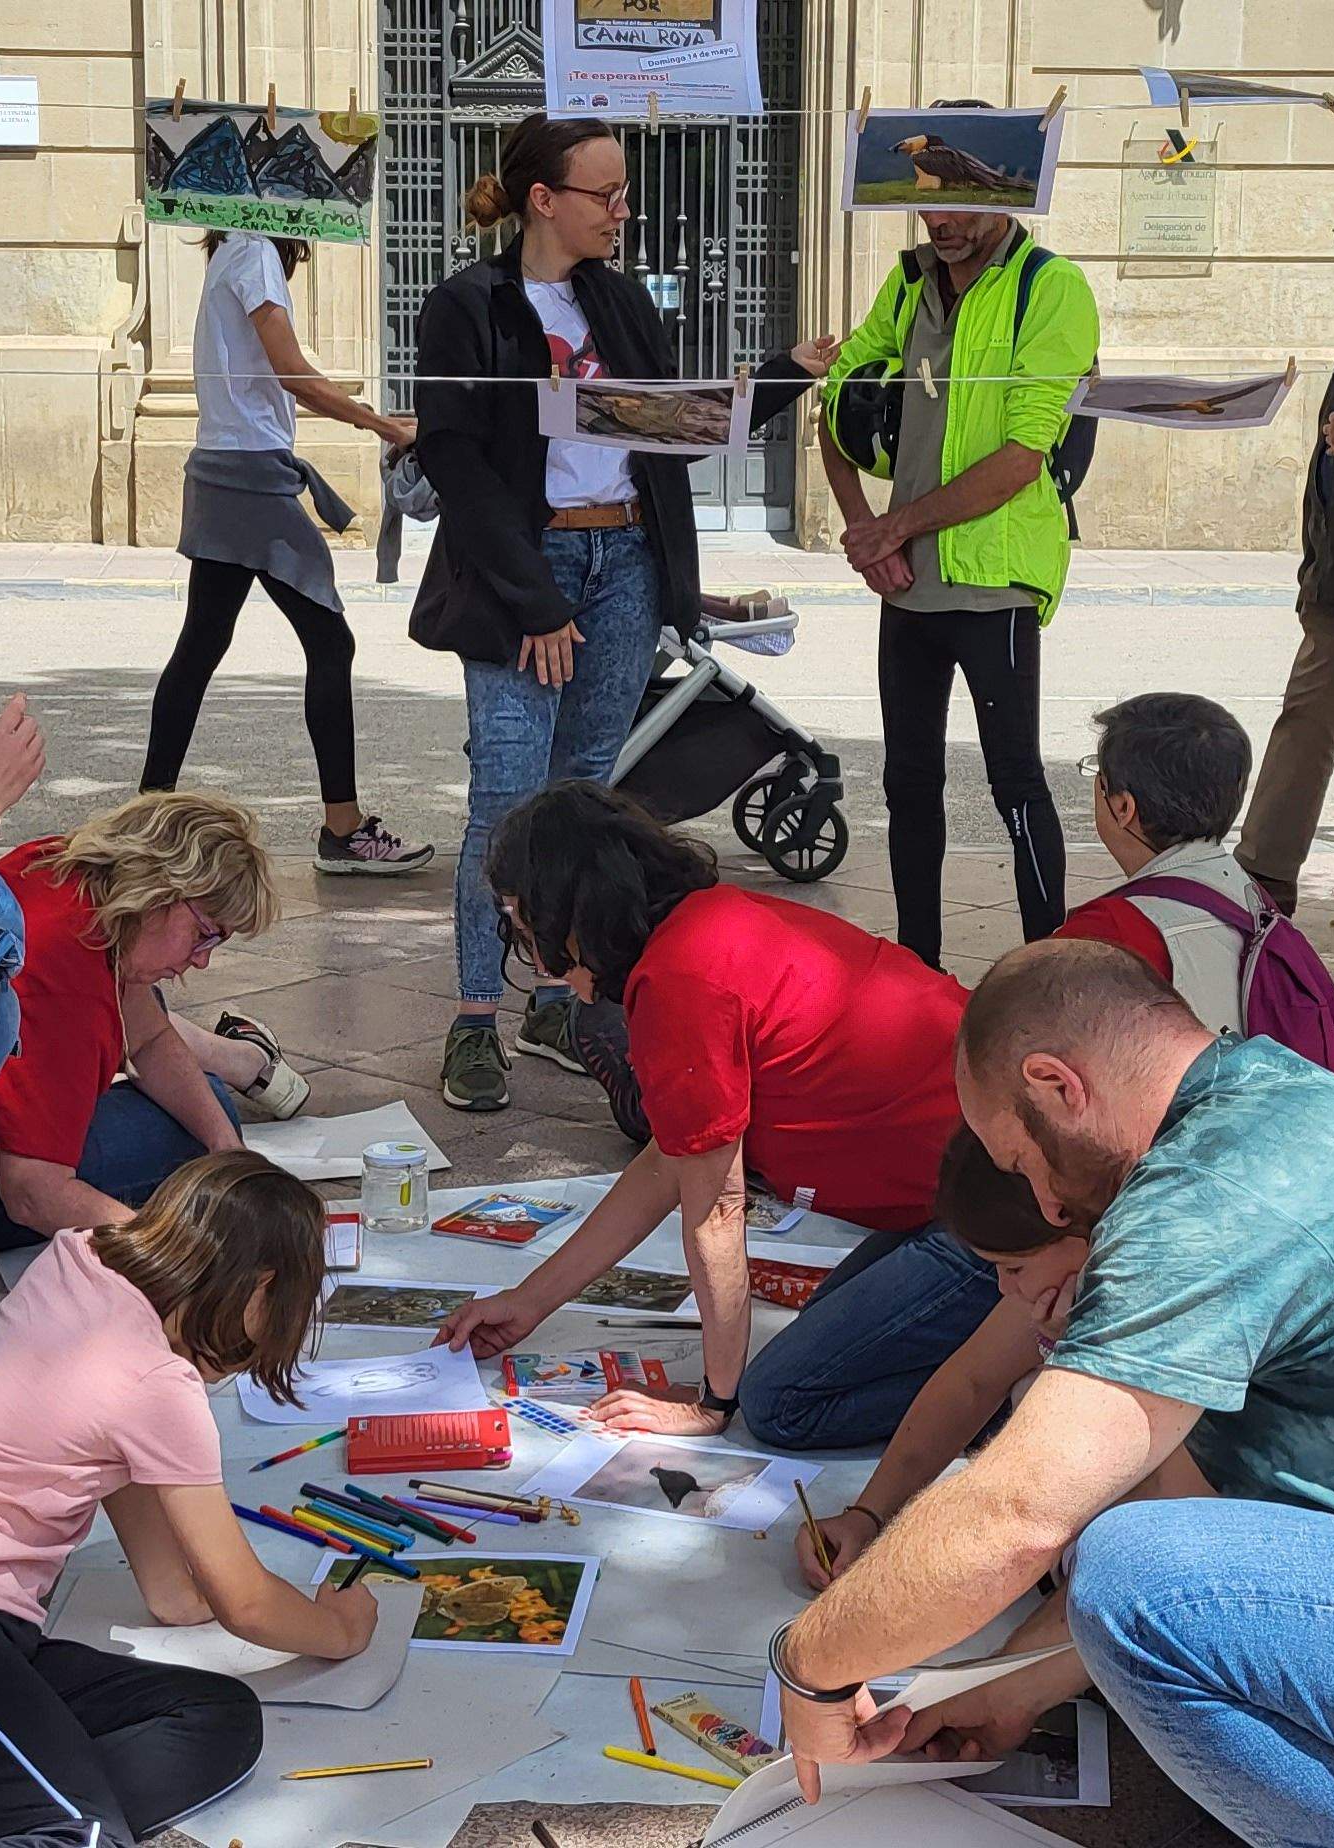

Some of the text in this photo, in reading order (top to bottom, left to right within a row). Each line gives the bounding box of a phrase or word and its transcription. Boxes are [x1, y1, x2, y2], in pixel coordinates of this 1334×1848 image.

[582, 27, 705, 46] CANAL ROYA
[647, 47, 734, 68] Domingo 14 de mayo
[591, 72, 669, 83] esperamos!
[230, 219, 321, 238] CANAL ROYA
